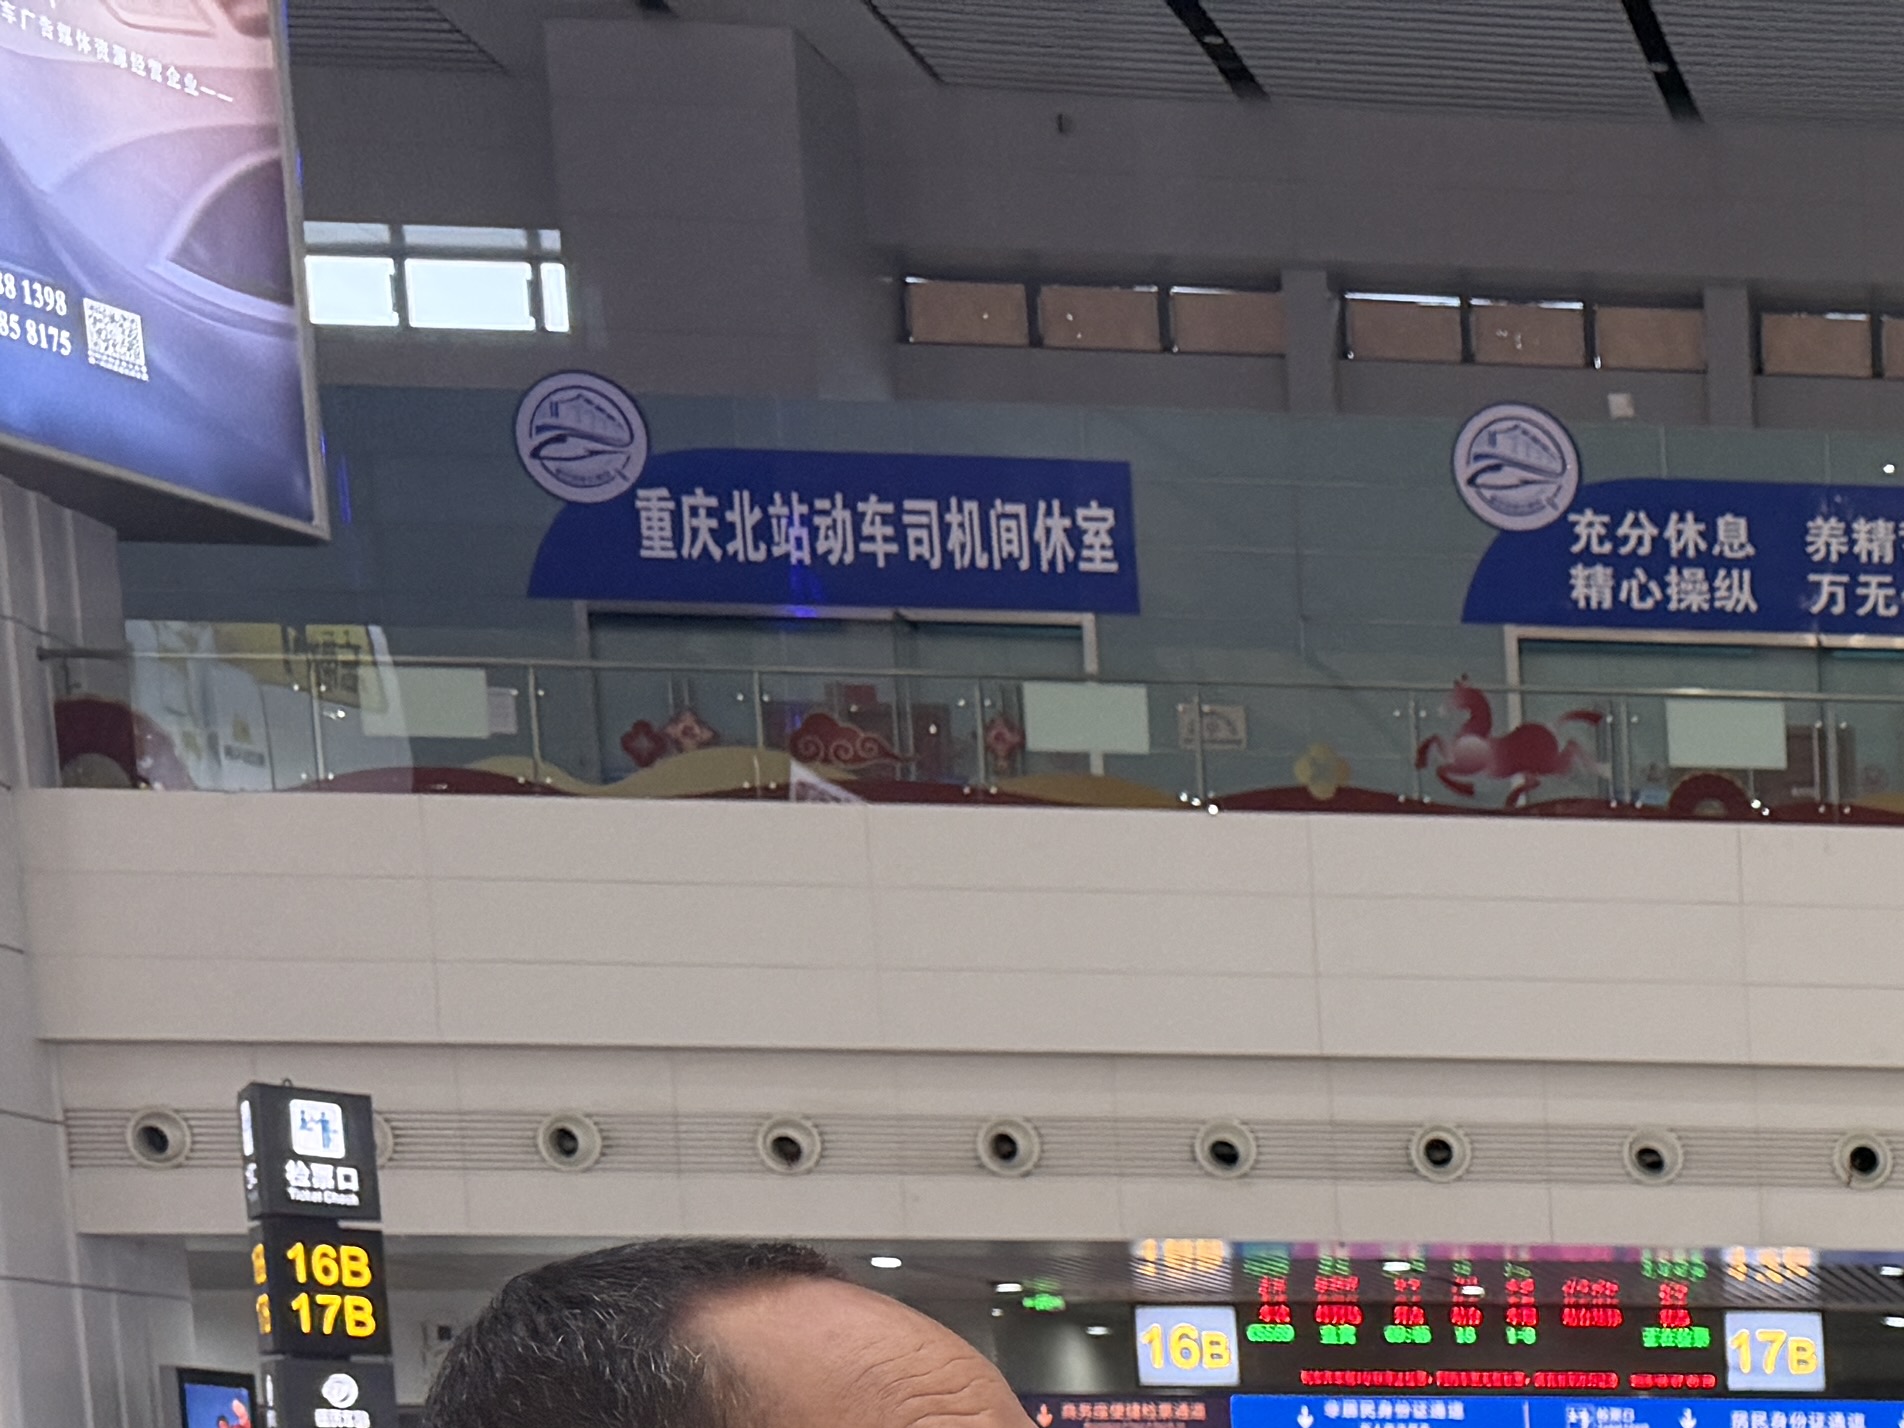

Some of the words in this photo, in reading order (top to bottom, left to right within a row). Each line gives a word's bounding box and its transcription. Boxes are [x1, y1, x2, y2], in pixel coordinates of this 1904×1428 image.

[21, 279, 67, 316] 1398
[25, 319, 72, 356] 8175
[635, 487, 1119, 574] 重庆北站动车司机间休室
[1567, 508, 1755, 559] 充分休息
[1568, 564, 1758, 614] 精心操纵
[287, 1242, 372, 1288] 16B
[291, 1292, 376, 1337] 17B
[1139, 1322, 1232, 1370] 16B
[1728, 1328, 1818, 1375] 17B
